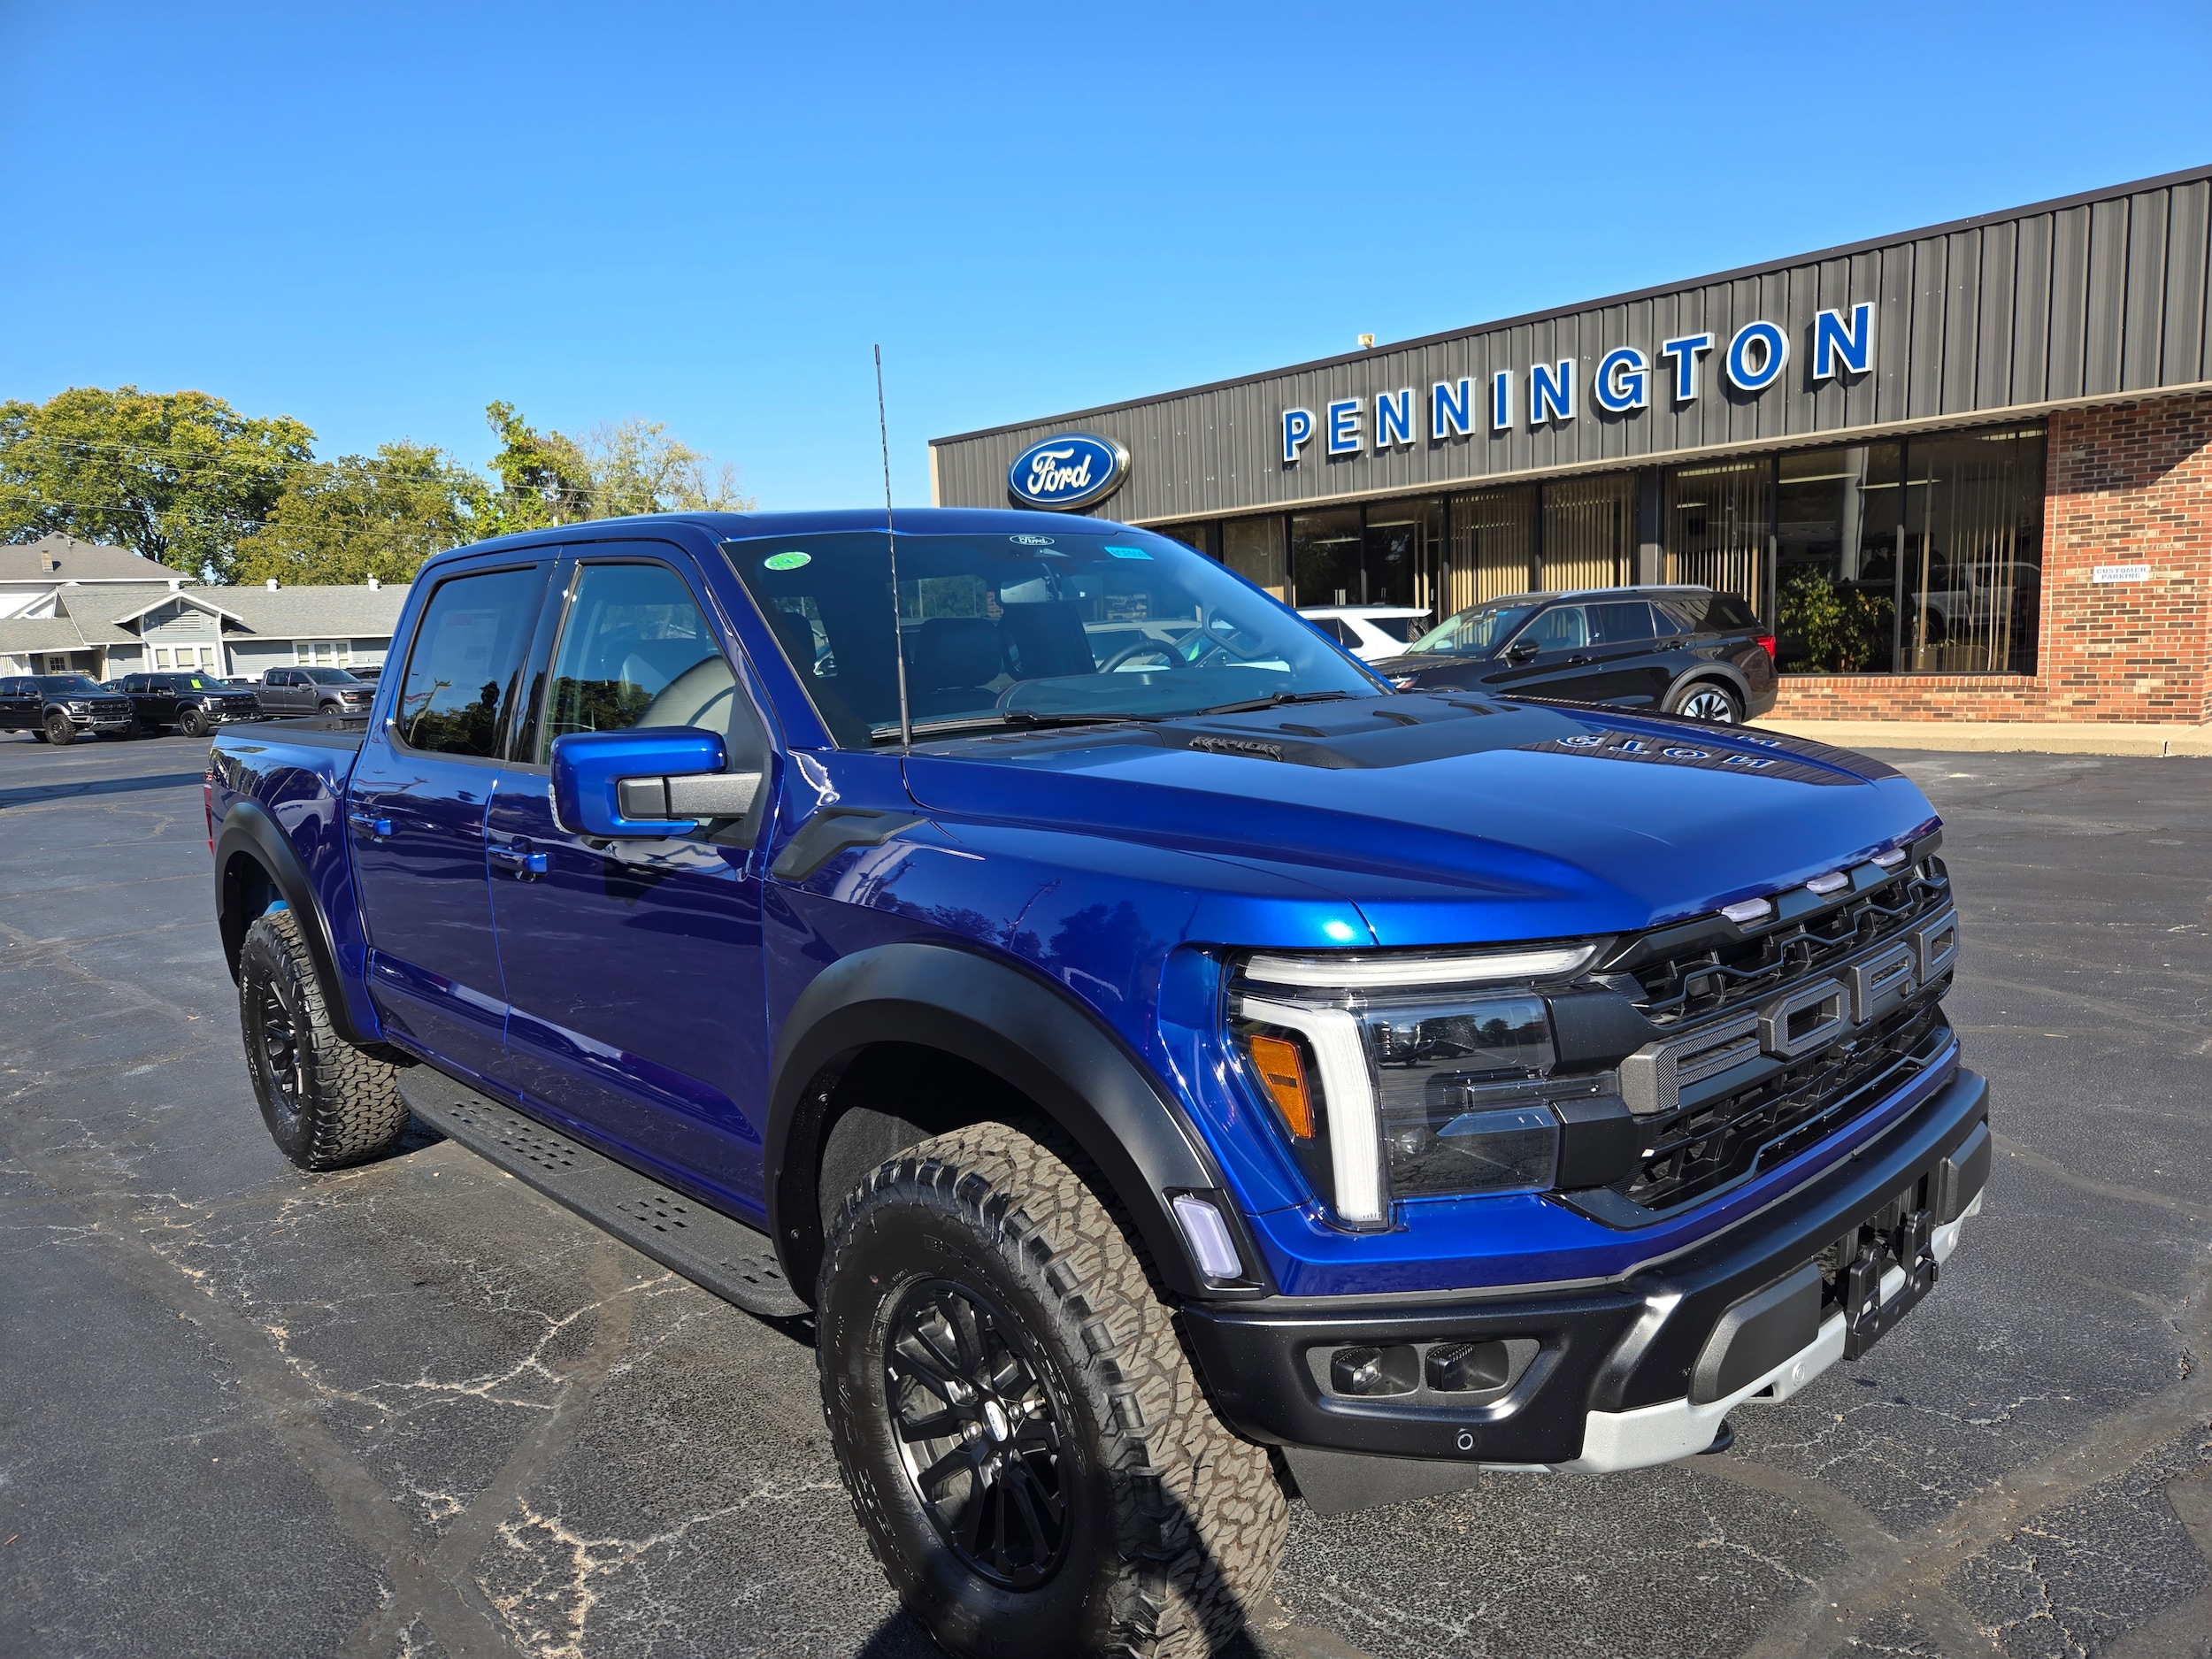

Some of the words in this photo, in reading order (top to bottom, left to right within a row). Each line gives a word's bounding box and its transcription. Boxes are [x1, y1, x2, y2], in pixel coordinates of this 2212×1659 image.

[1283, 302, 1876, 463] PENNINGTON
[1027, 448, 1092, 495] Ford
[1018, 535, 1049, 545] Ford
[1188, 735, 1284, 762] RAPTOR
[1621, 908, 1959, 1116] FORD
